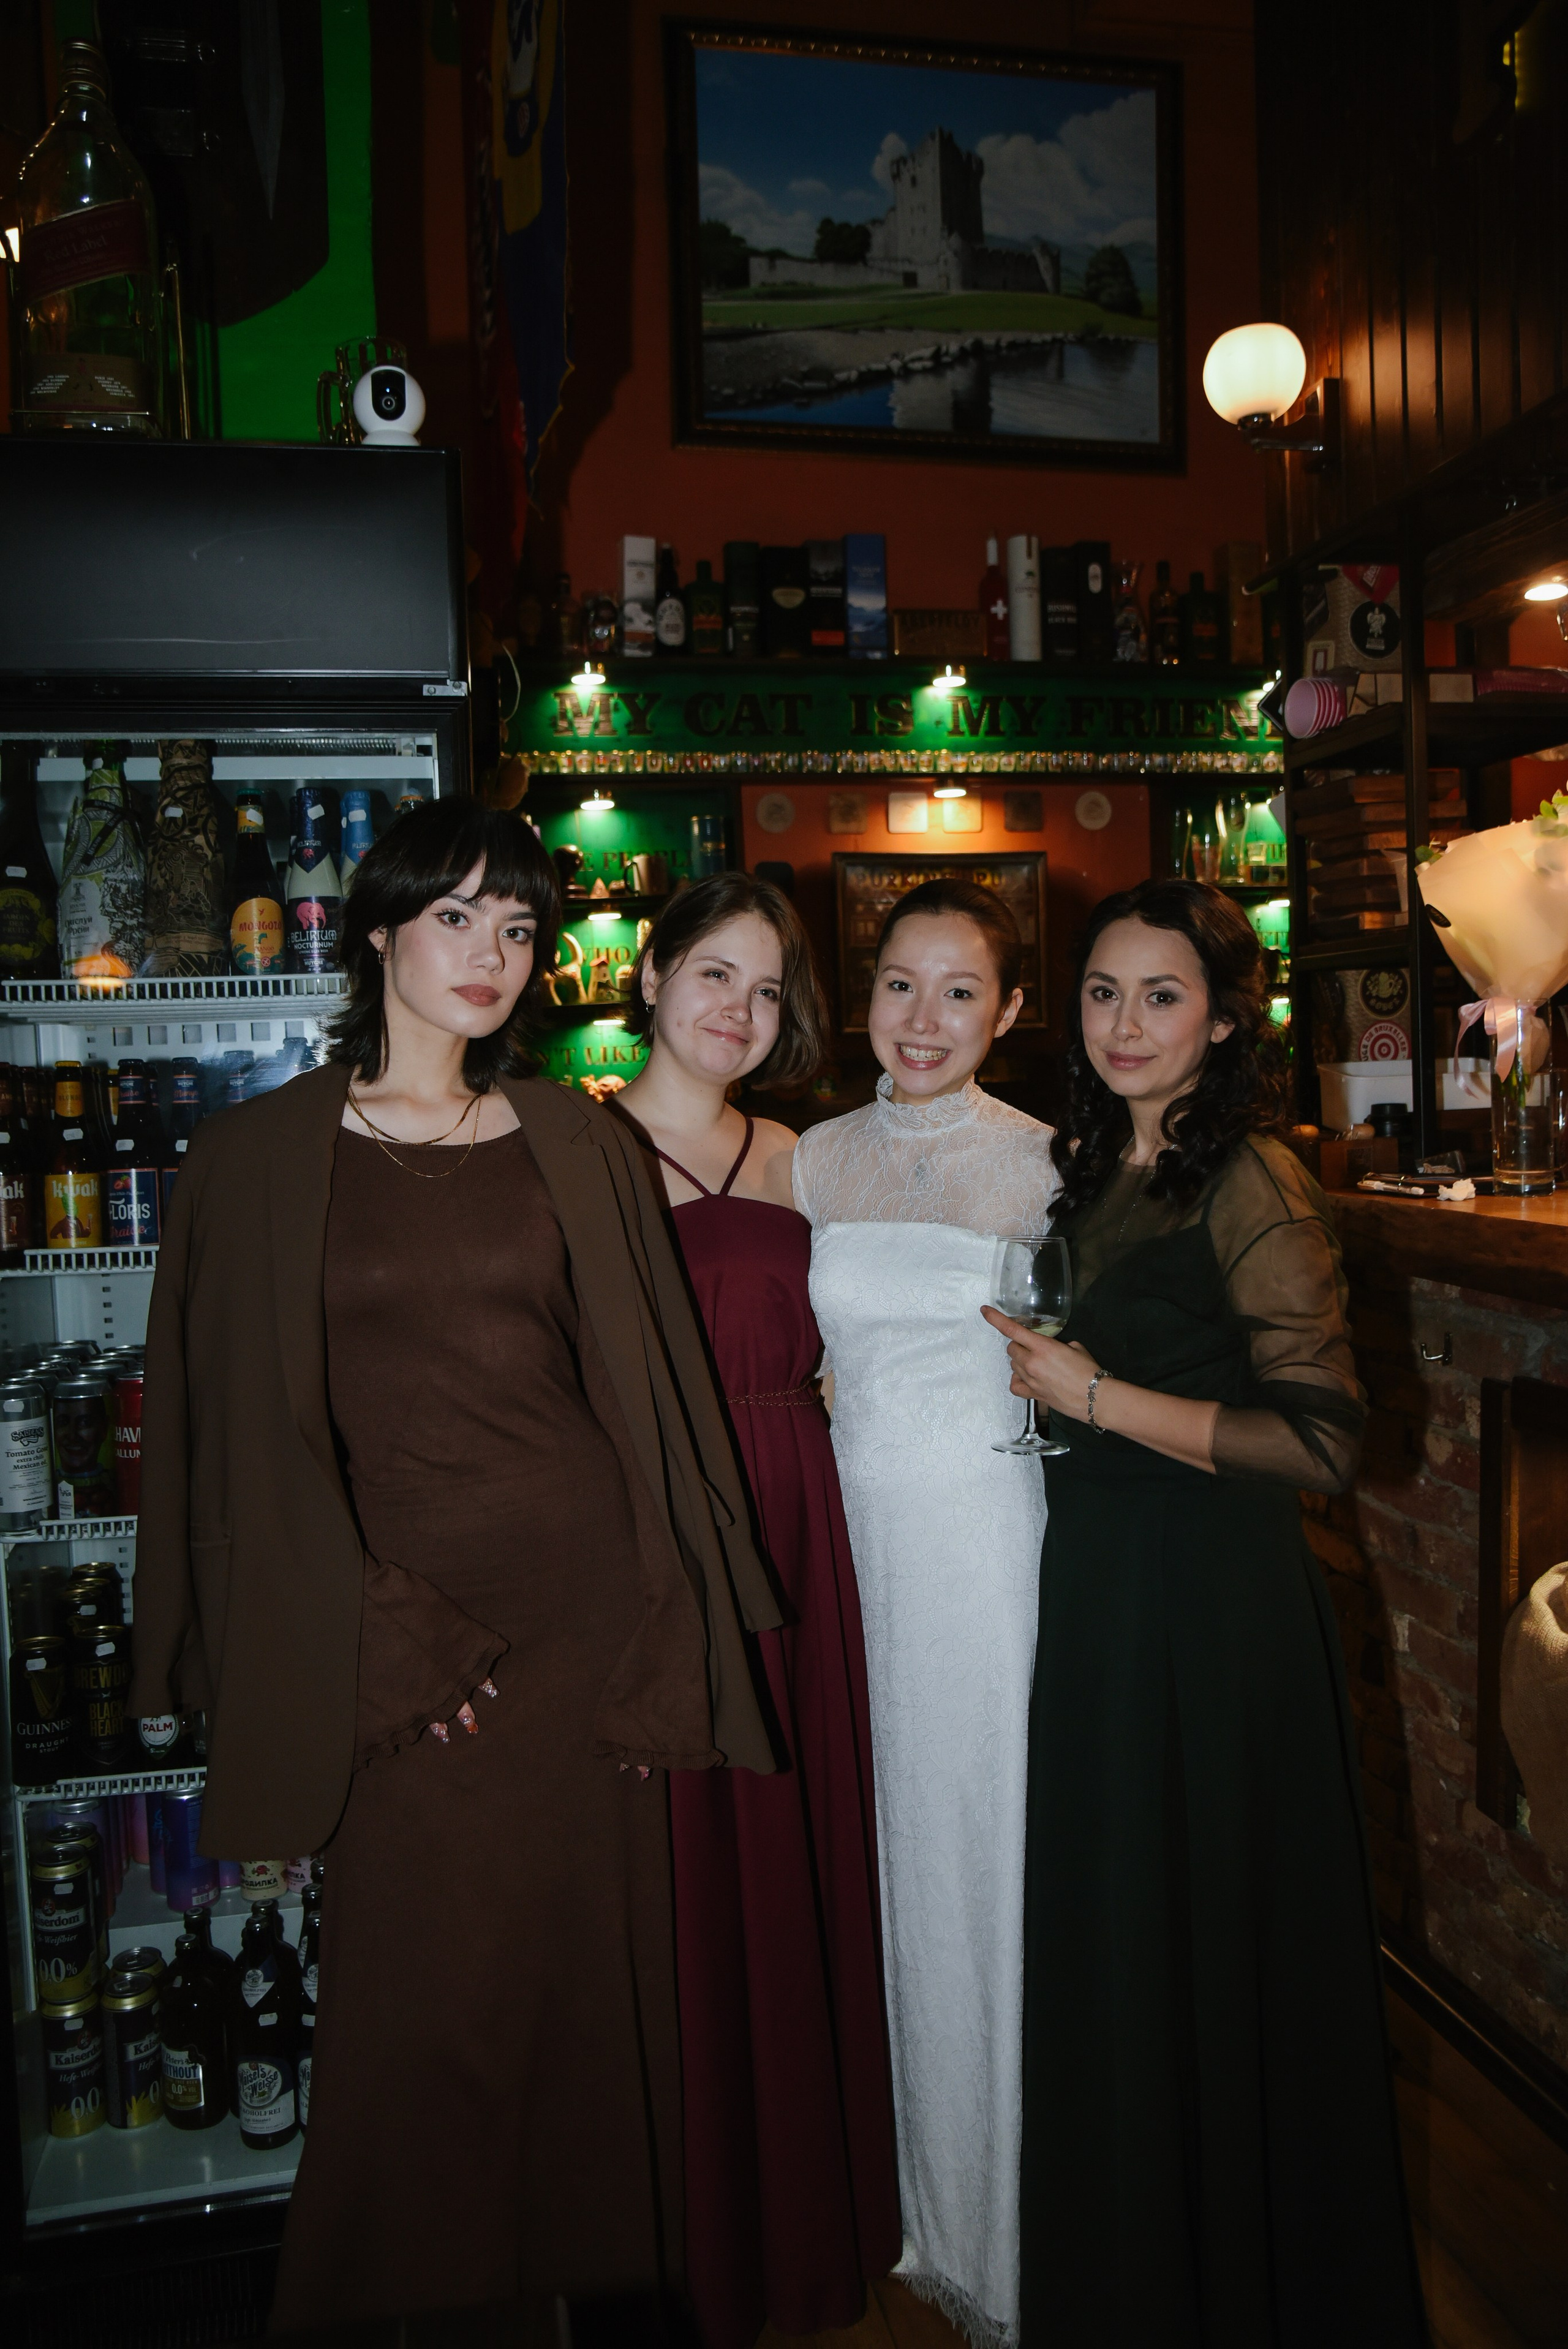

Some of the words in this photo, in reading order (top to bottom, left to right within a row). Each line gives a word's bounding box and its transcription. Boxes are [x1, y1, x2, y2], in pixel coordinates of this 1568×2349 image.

[72, 235, 108, 254] Label
[553, 692, 662, 737] MY
[684, 692, 812, 736] CAT
[850, 693, 914, 738] IS
[946, 695, 1046, 737] MY
[290, 930, 337, 944] DELIRIUM
[294, 941, 334, 950] NOCTURNUM
[584, 1046, 646, 1066] LIKE
[108, 1197, 151, 1221] FLORIS
[6, 1449, 36, 1458] Tomato
[12, 1461, 40, 1471] Mexican
[143, 1722, 173, 1733] PALM
[25, 1736, 69, 1749] DRAUGHT
